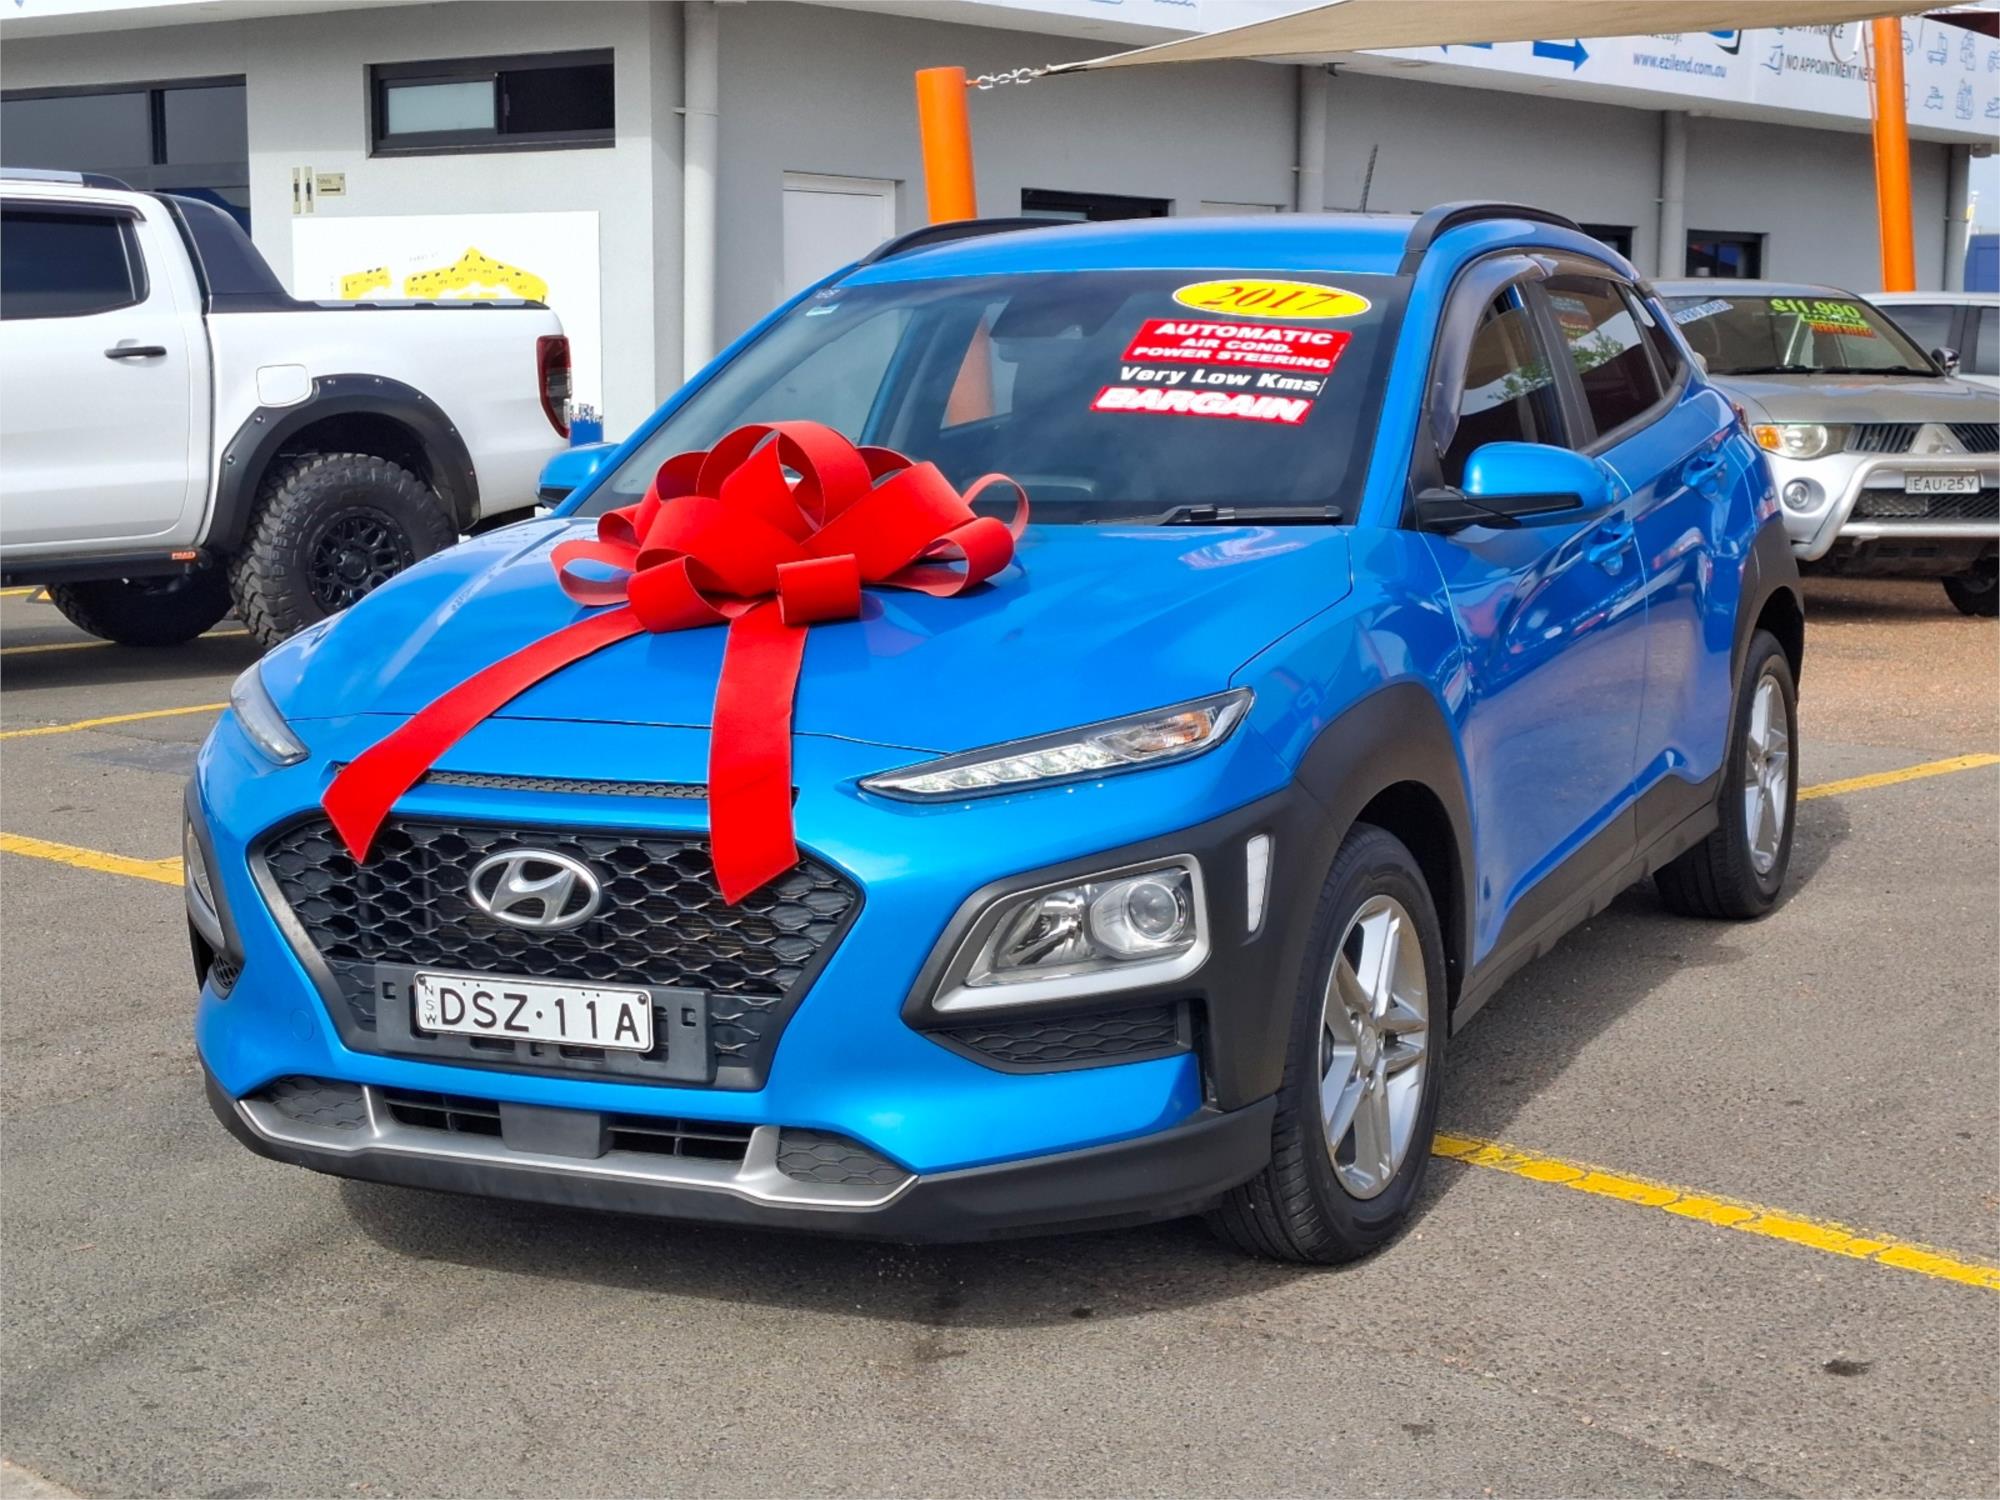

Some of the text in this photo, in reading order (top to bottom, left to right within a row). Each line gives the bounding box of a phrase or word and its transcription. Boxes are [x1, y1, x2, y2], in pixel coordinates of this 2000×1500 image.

[1785, 55, 1799, 70] NO
[1800, 56, 1858, 80] APPOINTMENT
[1199, 285, 1346, 311] 2017
[1154, 322, 1334, 346] AUTOMATIC
[1180, 337, 1293, 353] AIR COND.
[1132, 346, 1331, 368] POWER STEERING
[1120, 366, 1321, 393] Very Low Kms
[1095, 387, 1311, 423] BARGAIN
